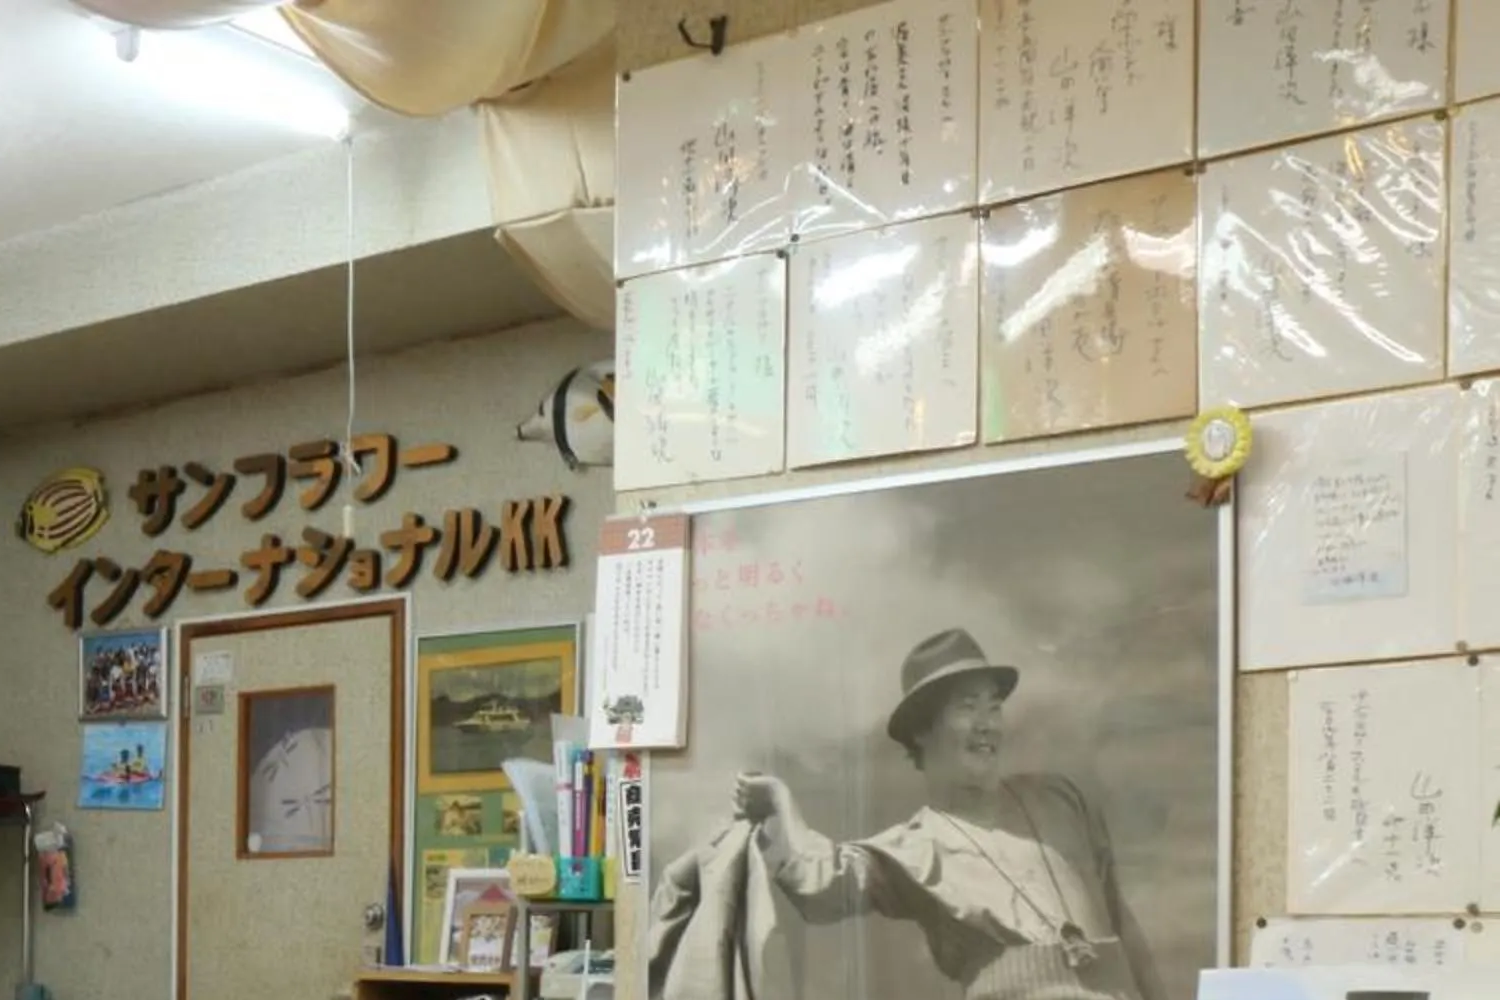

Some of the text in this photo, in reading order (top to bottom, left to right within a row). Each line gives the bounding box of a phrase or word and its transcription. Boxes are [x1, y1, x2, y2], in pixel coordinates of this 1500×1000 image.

[128, 433, 457, 537] サンフラワー
[47, 495, 571, 630] インターナショナルKK
[627, 529, 656, 549] 22
